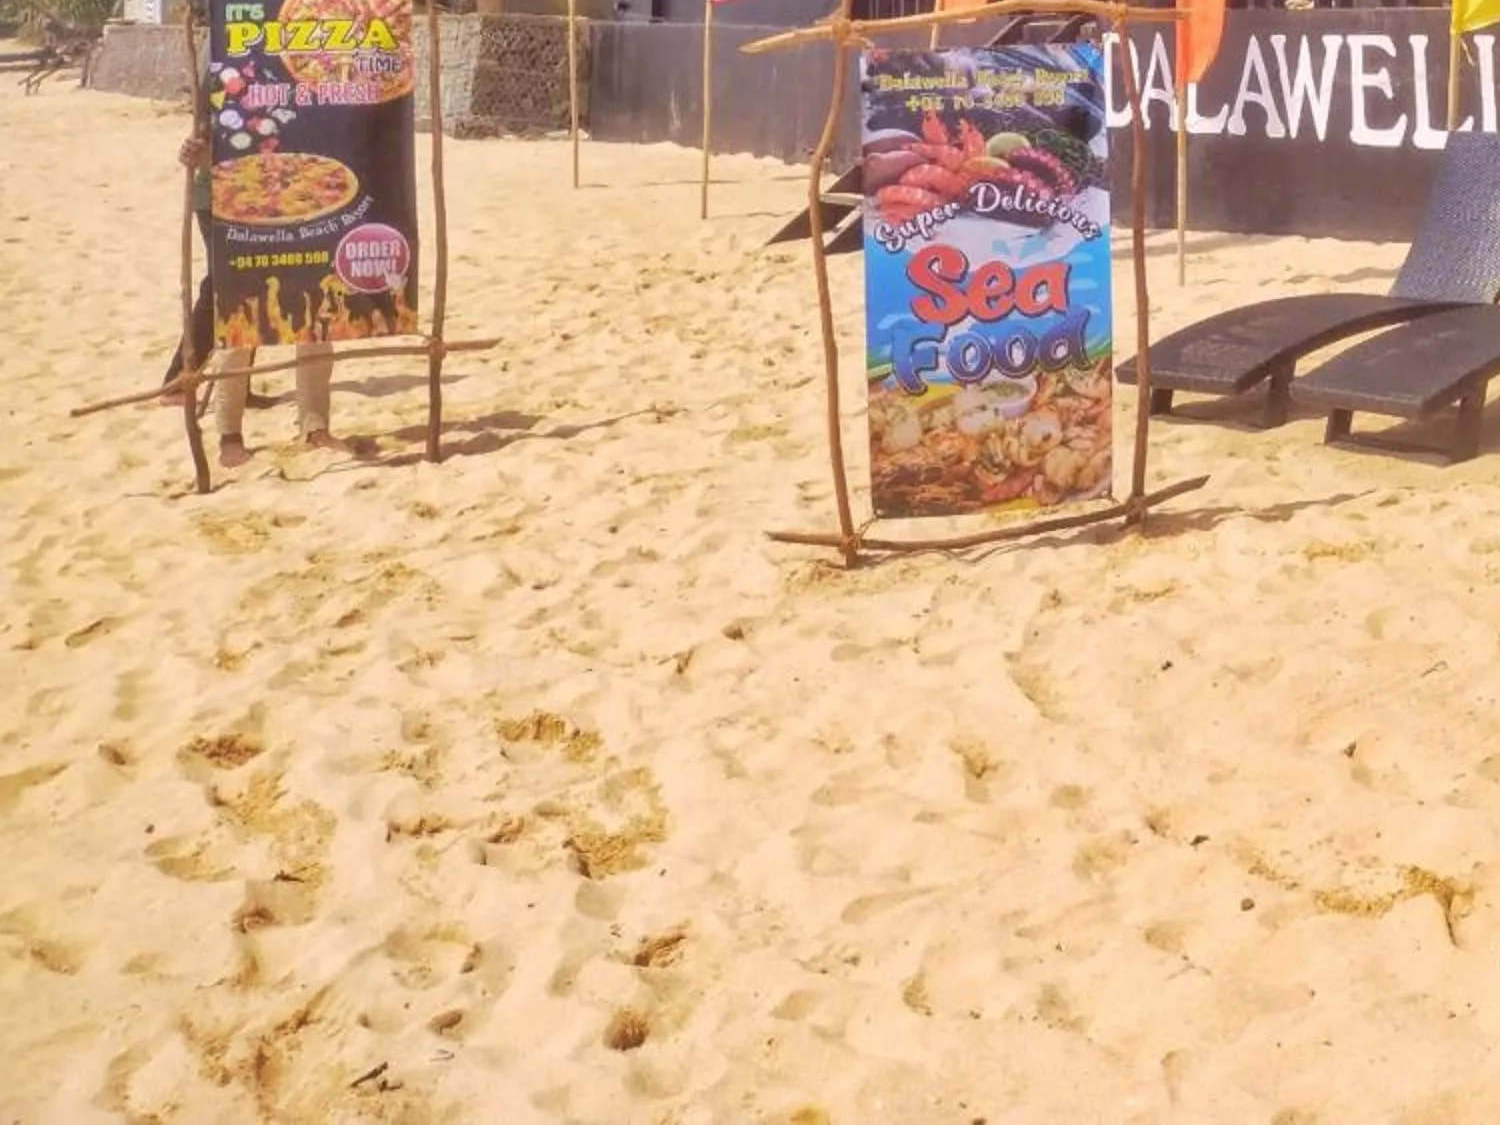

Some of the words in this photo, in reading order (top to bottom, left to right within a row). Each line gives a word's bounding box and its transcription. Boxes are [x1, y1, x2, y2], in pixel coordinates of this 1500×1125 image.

[226, 18, 399, 56] PIZZA
[357, 56, 401, 73] TIME
[247, 82, 291, 105] HOT
[295, 82, 312, 106] &
[316, 81, 380, 104] FRESH
[874, 201, 961, 253] Super
[968, 180, 1103, 241] Delicious
[345, 239, 401, 259] ORDER
[906, 242, 1071, 326] Sea
[888, 309, 1091, 396] Food
